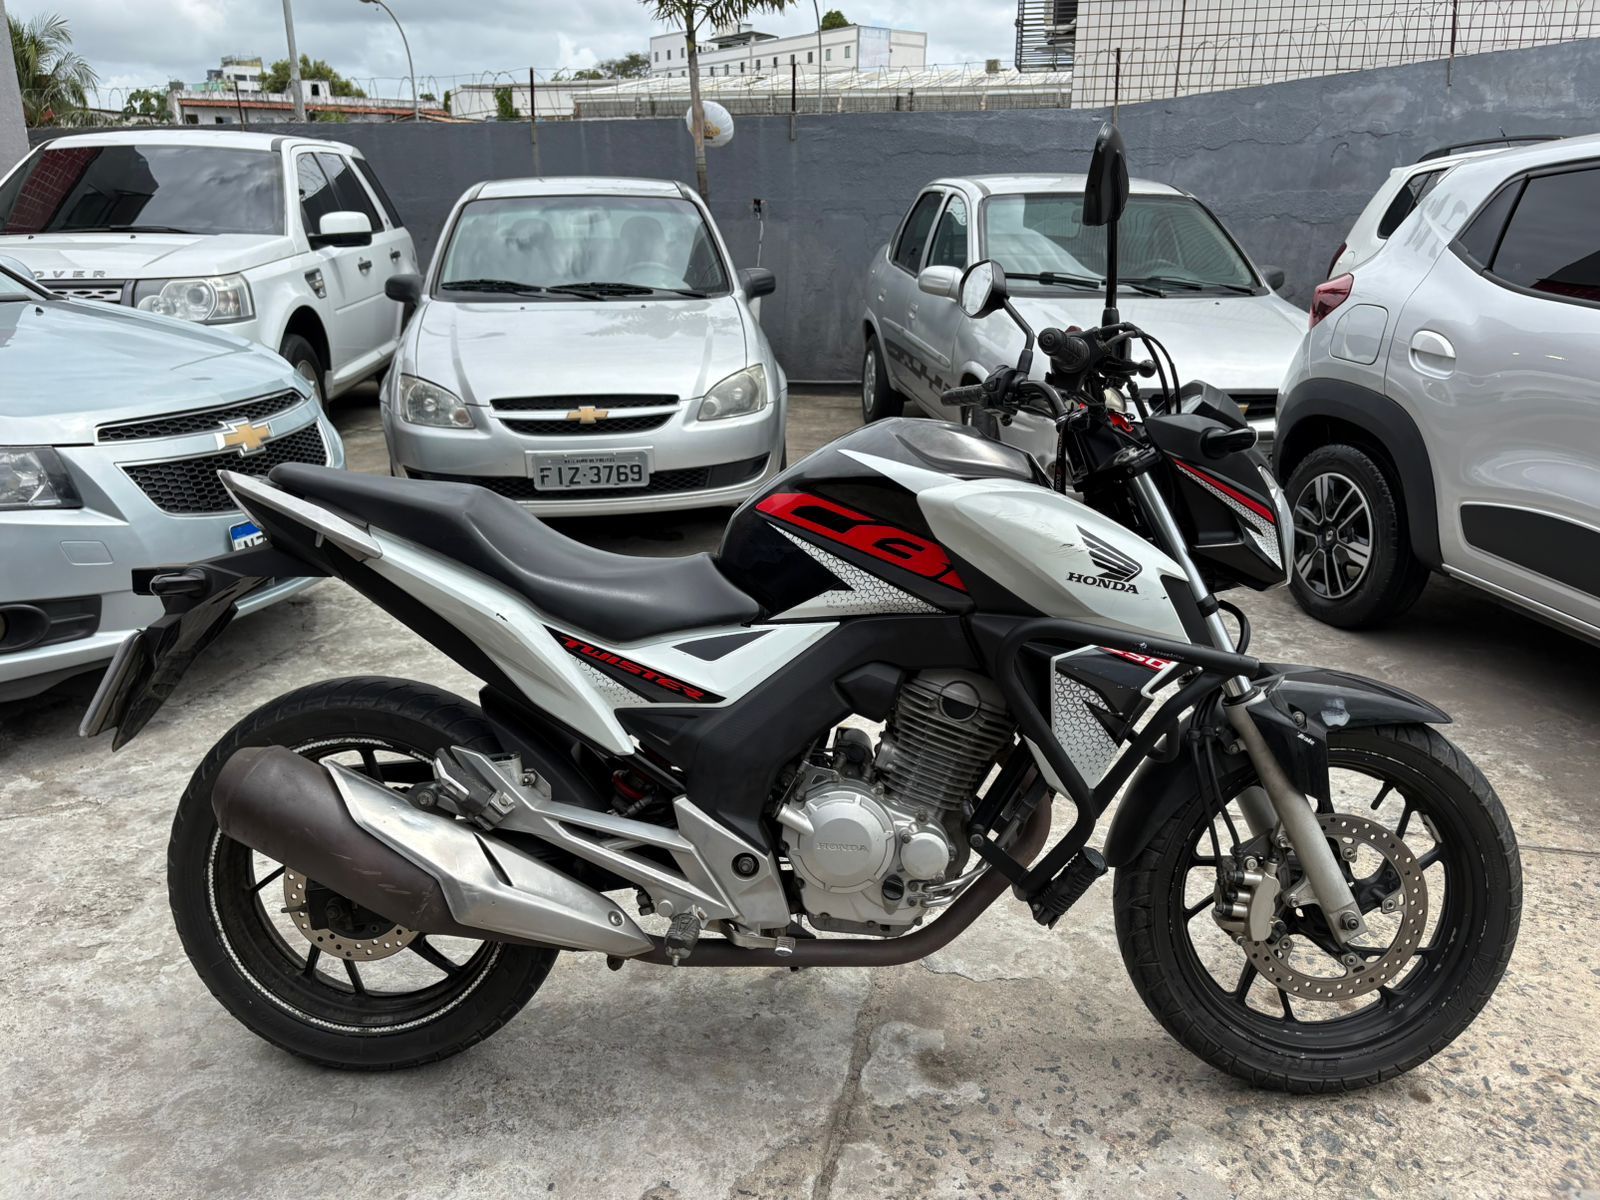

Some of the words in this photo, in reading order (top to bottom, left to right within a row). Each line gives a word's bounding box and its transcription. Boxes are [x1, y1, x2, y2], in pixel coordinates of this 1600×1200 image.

[33, 270, 105, 278] OVER
[1066, 571, 1140, 595] HONDA
[560, 635, 705, 701] TWISTER
[816, 842, 870, 852] HONDA
